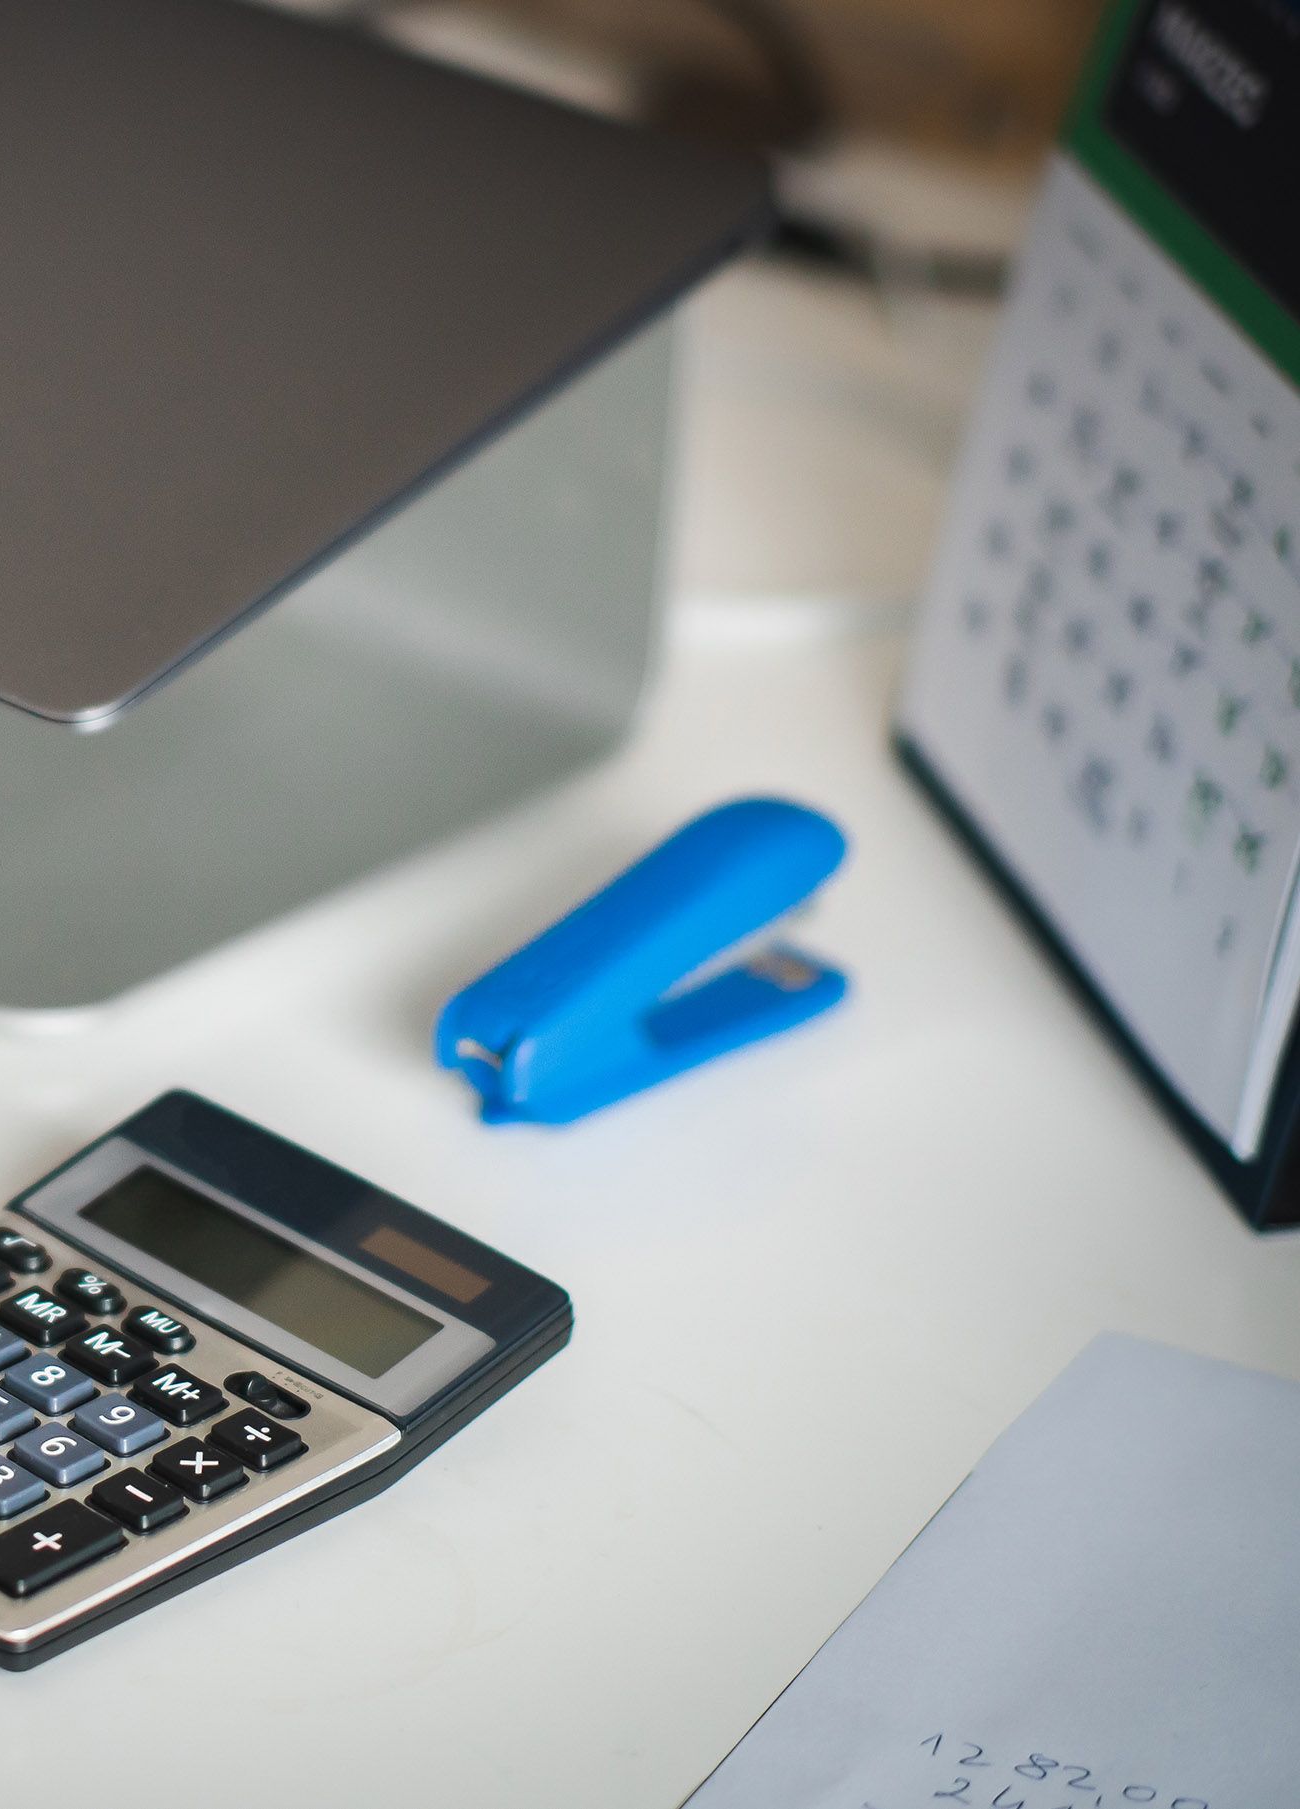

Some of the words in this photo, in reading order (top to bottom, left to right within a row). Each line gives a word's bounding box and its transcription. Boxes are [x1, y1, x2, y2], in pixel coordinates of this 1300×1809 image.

[79, 1275, 102, 1295] %
[15, 1292, 67, 1323] MR
[140, 1311, 182, 1334] MU
[31, 1366, 65, 1385] 8
[152, 1371, 201, 1400] M+
[99, 1406, 135, 1424] 9
[41, 1437, 77, 1455] 6
